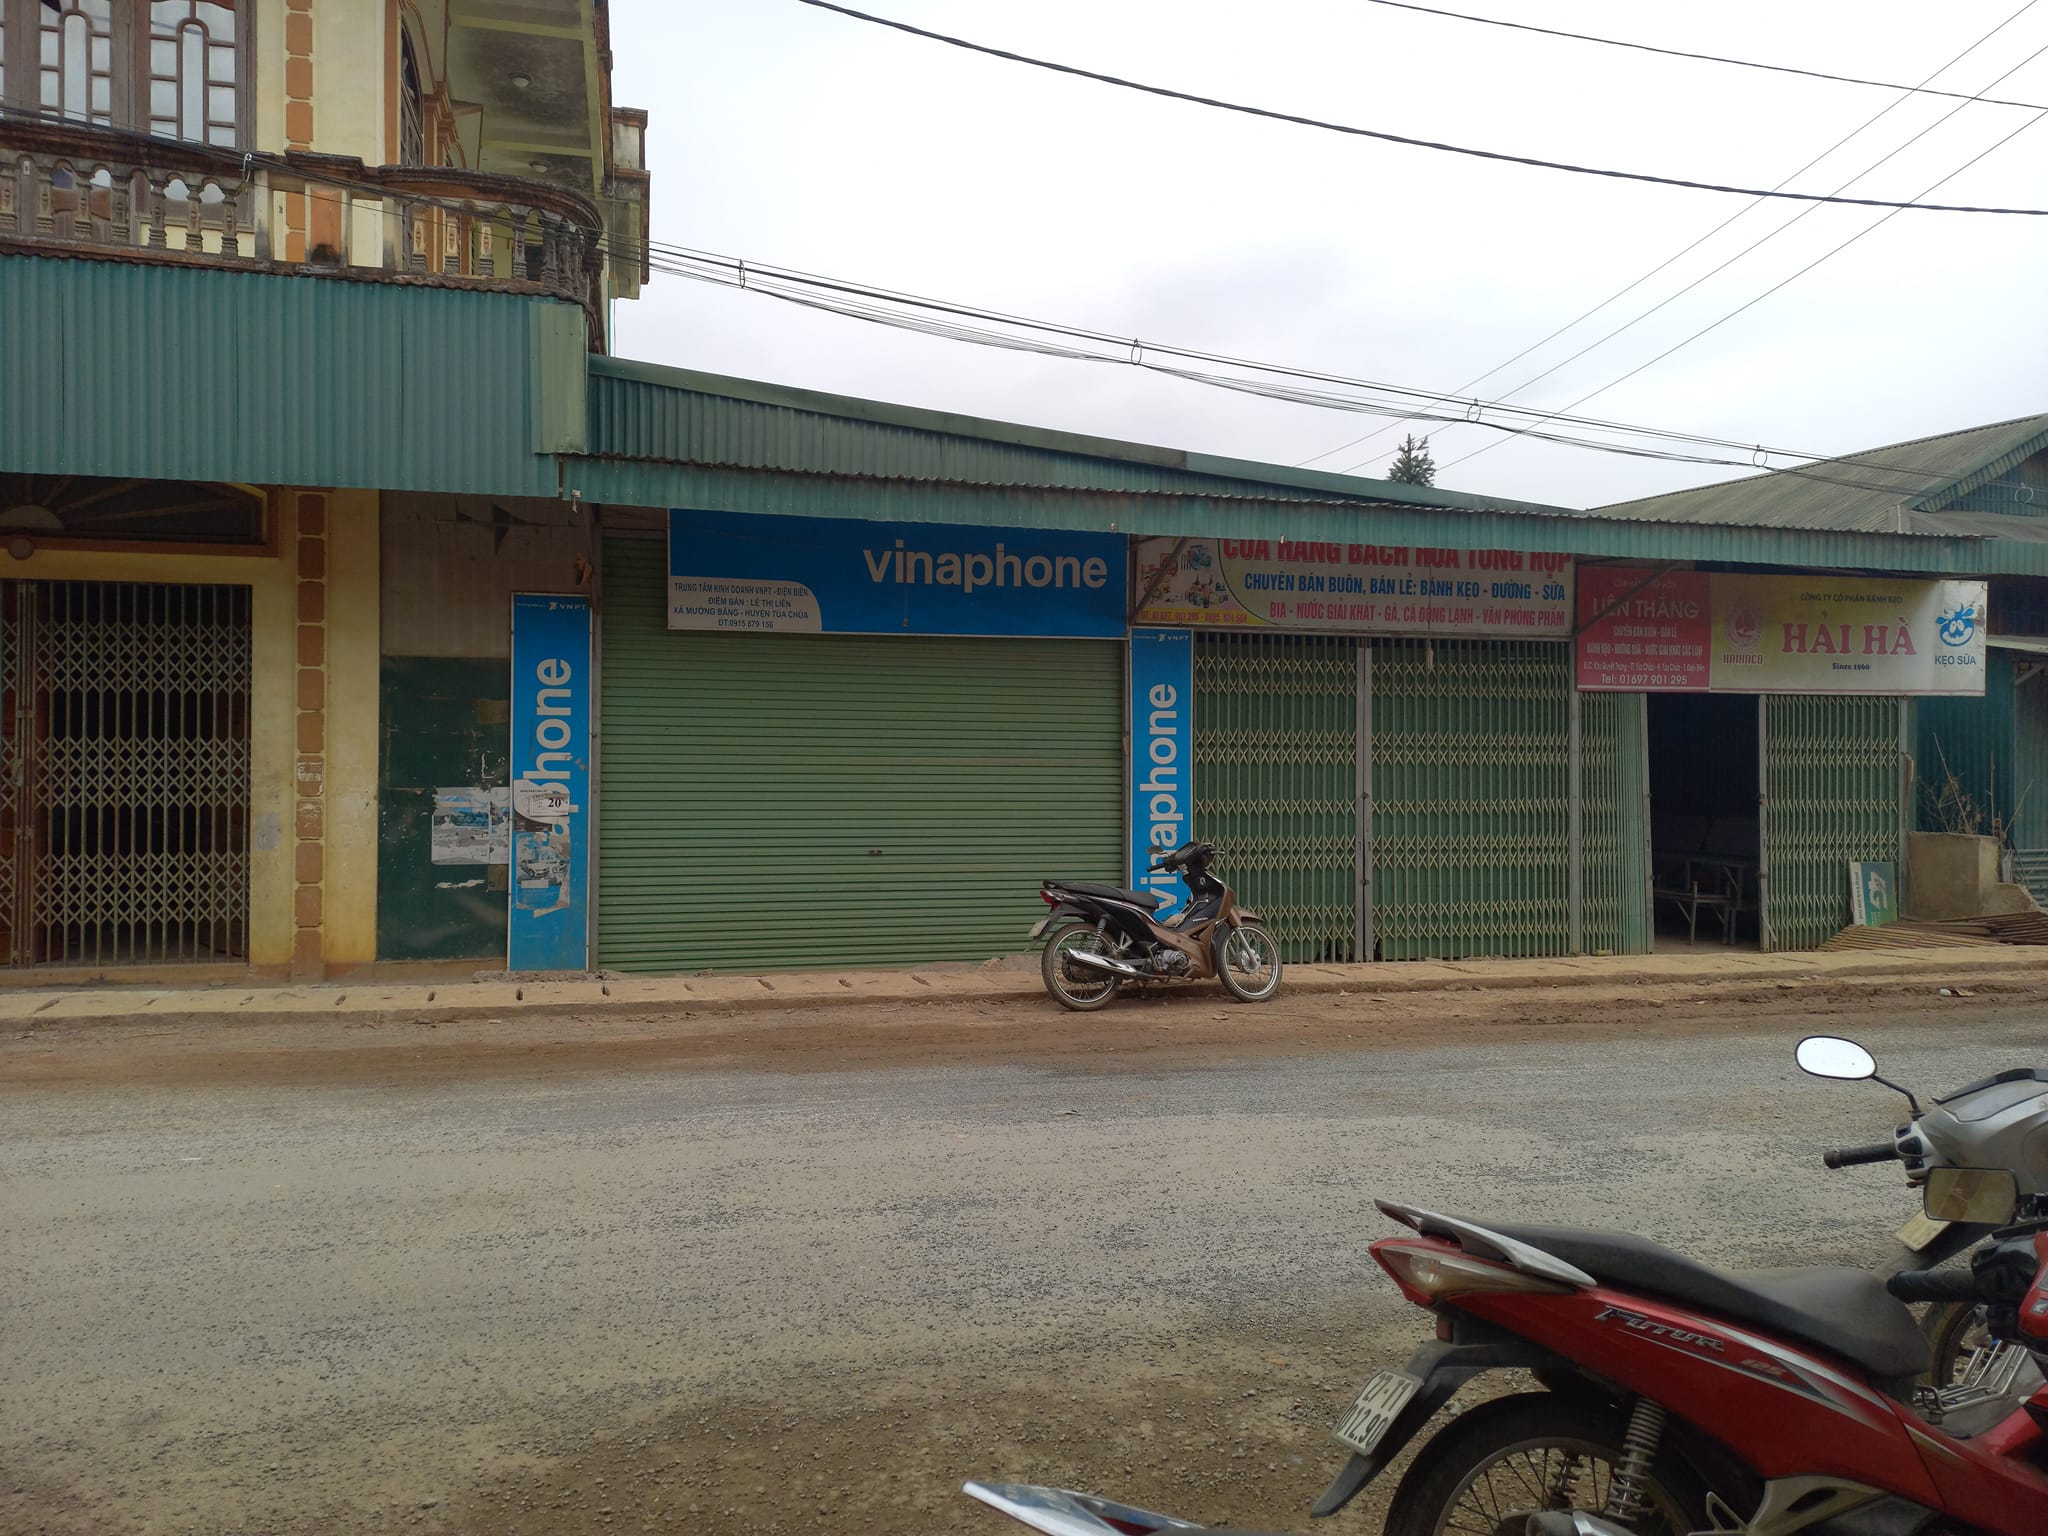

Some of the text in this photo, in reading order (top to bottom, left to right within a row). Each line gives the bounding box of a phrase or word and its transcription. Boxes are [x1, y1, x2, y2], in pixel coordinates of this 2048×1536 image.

[863, 539, 1109, 593] vinaphone
[674, 583, 697, 592] TRUNG
[698, 582, 713, 593] TÂM
[755, 585, 772, 595] VNPT
[1244, 571, 1565, 601] CHUYÊN BÁN BUÔN, BÁN LẺ: BÁNH KẸO ĐƯỜNG SỮA
[1800, 592, 1822, 601] CÔNG
[1270, 601, 1286, 618] BIA
[1296, 598, 1325, 620] NƯỚC
[1327, 596, 1347, 621] GIẢI
[1350, 601, 1376, 621] KHÁT
[1448, 607, 1473, 627] LẠNH
[1503, 605, 1536, 626] PHÒNG
[1592, 593, 1699, 619] LIÊN THẮNG
[748, 619, 760, 628] 879
[762, 620, 774, 629] 156
[1781, 610, 1852, 654] HẢI
[1862, 616, 1916, 655] HÀ
[1832, 662, 1852, 670] Since
[1934, 653, 1977, 668] KẸO SỮA
[1600, 673, 1688, 685] Tel: 01697 901 295
[548, 798, 562, 808] 20
[1335, 1402, 1389, 1449] 012.90
